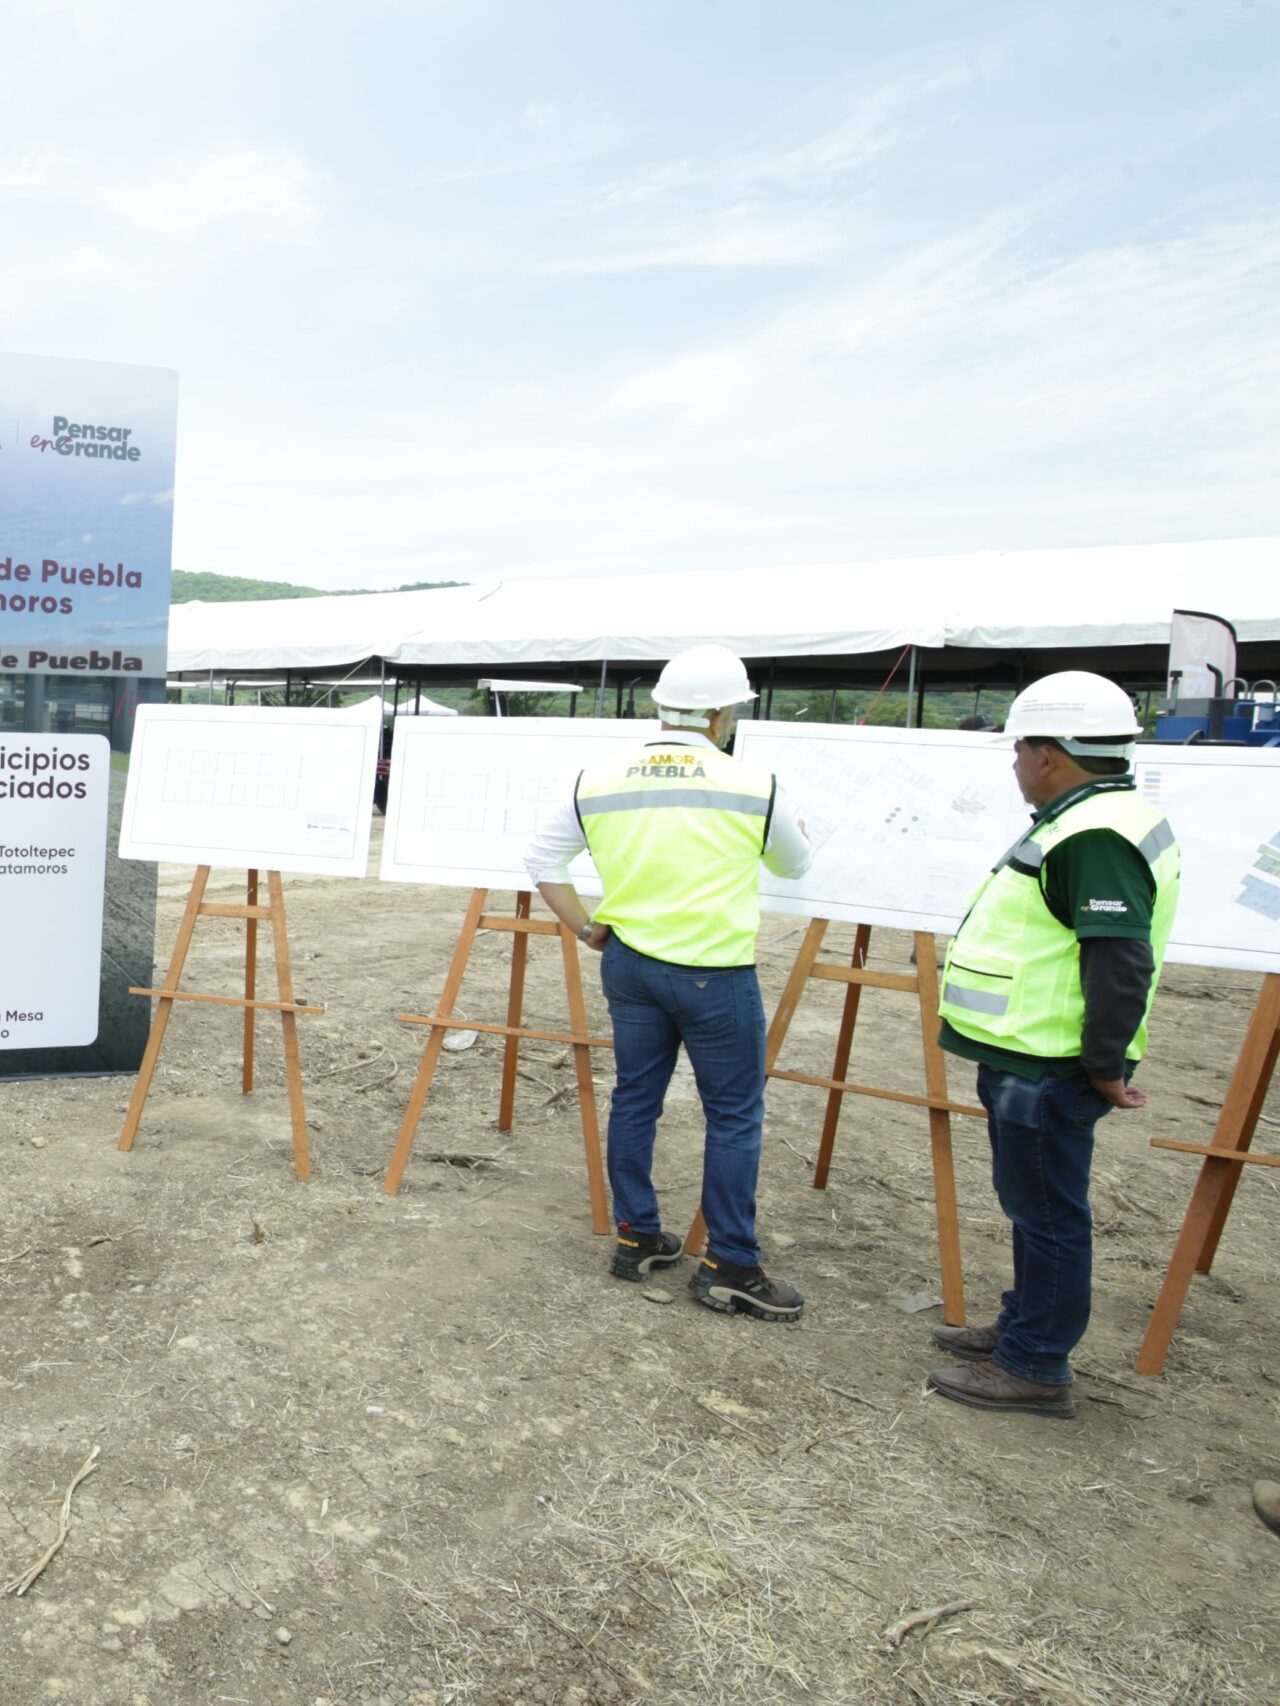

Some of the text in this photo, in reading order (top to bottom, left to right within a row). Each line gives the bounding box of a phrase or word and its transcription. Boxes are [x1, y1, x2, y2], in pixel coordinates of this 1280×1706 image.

[53, 415, 132, 442] Pensar
[30, 434, 141, 462] en Grande
[41, 559, 142, 589] Puebla
[28, 650, 143, 672] Puebla
[626, 765, 707, 778] PUEBLA
[1089, 898, 1124, 907] Pensar
[5, 1009, 44, 1023] Mesa
